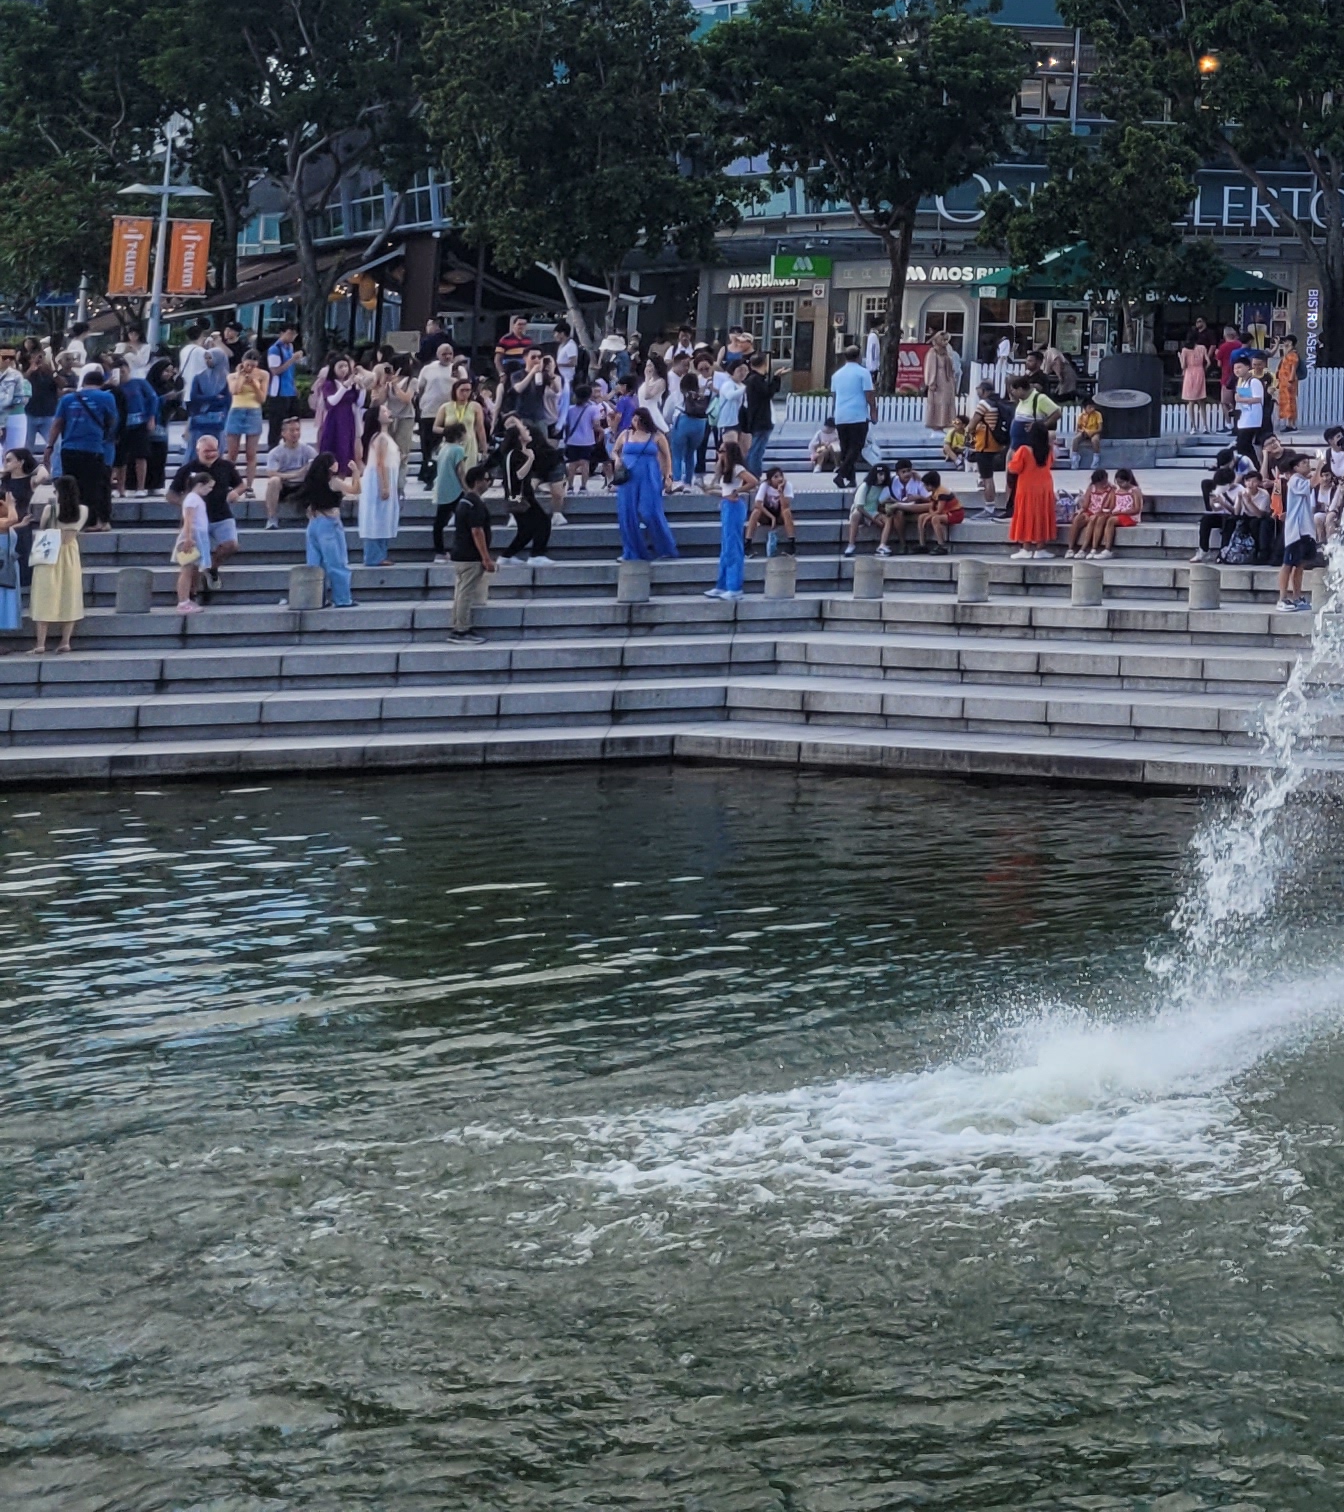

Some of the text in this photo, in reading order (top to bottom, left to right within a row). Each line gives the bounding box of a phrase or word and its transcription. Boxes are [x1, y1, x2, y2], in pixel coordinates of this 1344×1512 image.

[123, 241, 138, 286] 7-ELEVEN
[181, 242, 197, 287] 7-ELEVEN
[741, 274, 761, 289] MOS
[931, 266, 974, 281] MOS
[1307, 289, 1319, 329] BISTRO
